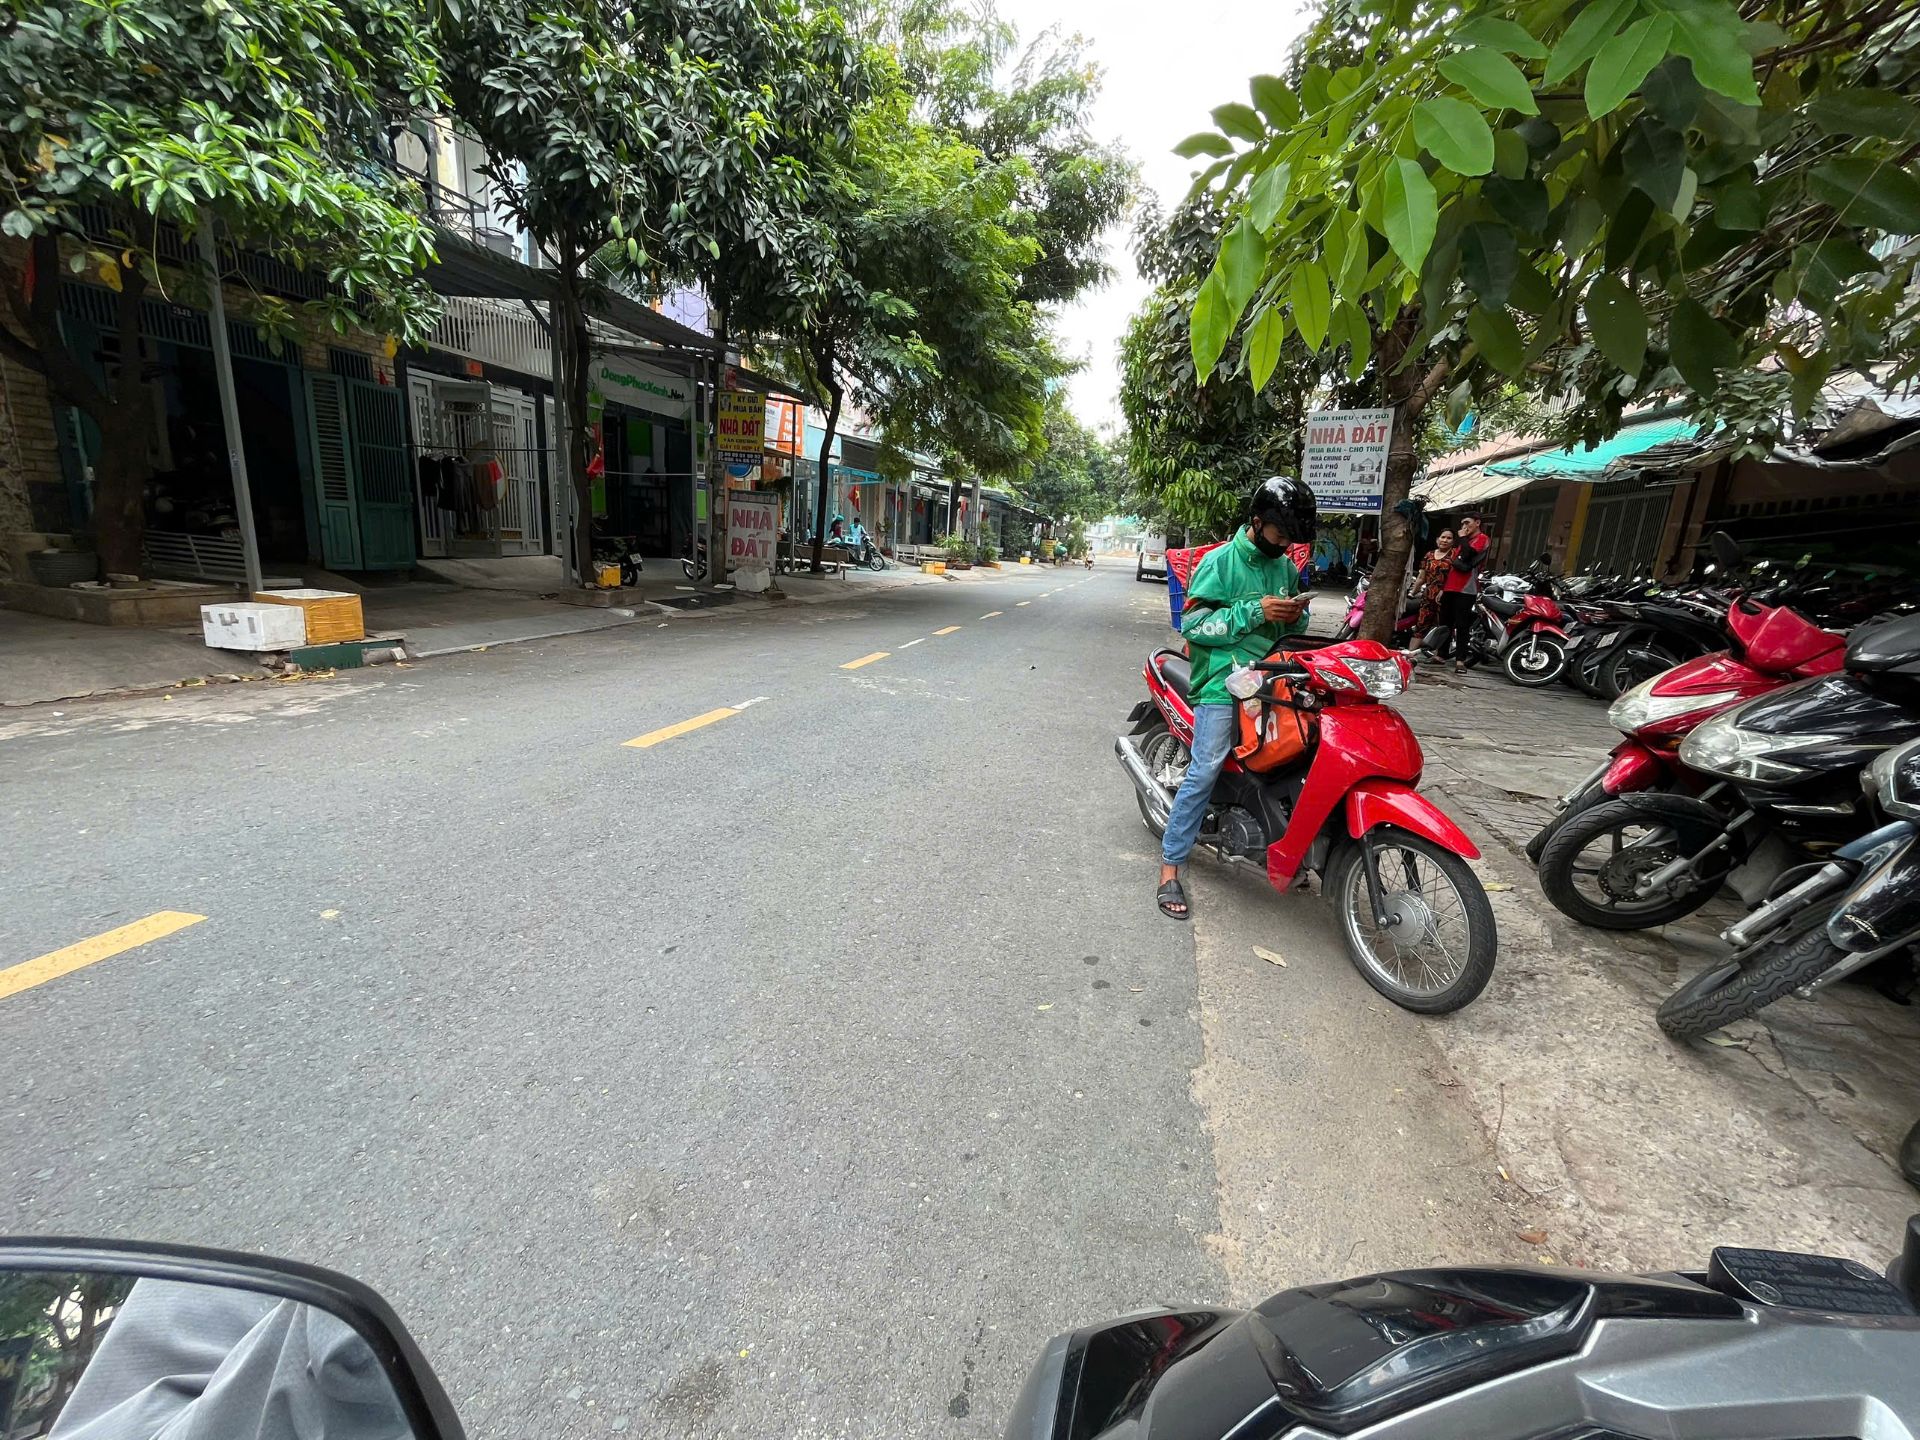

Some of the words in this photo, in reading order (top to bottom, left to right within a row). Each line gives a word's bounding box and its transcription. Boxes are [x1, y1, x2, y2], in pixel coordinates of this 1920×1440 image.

[720, 416, 738, 435] NHÀ
[1310, 424, 1346, 444] NHÀ
[1351, 420, 1388, 444] ĐẤT
[732, 505, 774, 531] NHÀ
[731, 531, 772, 559] ĐẤT
